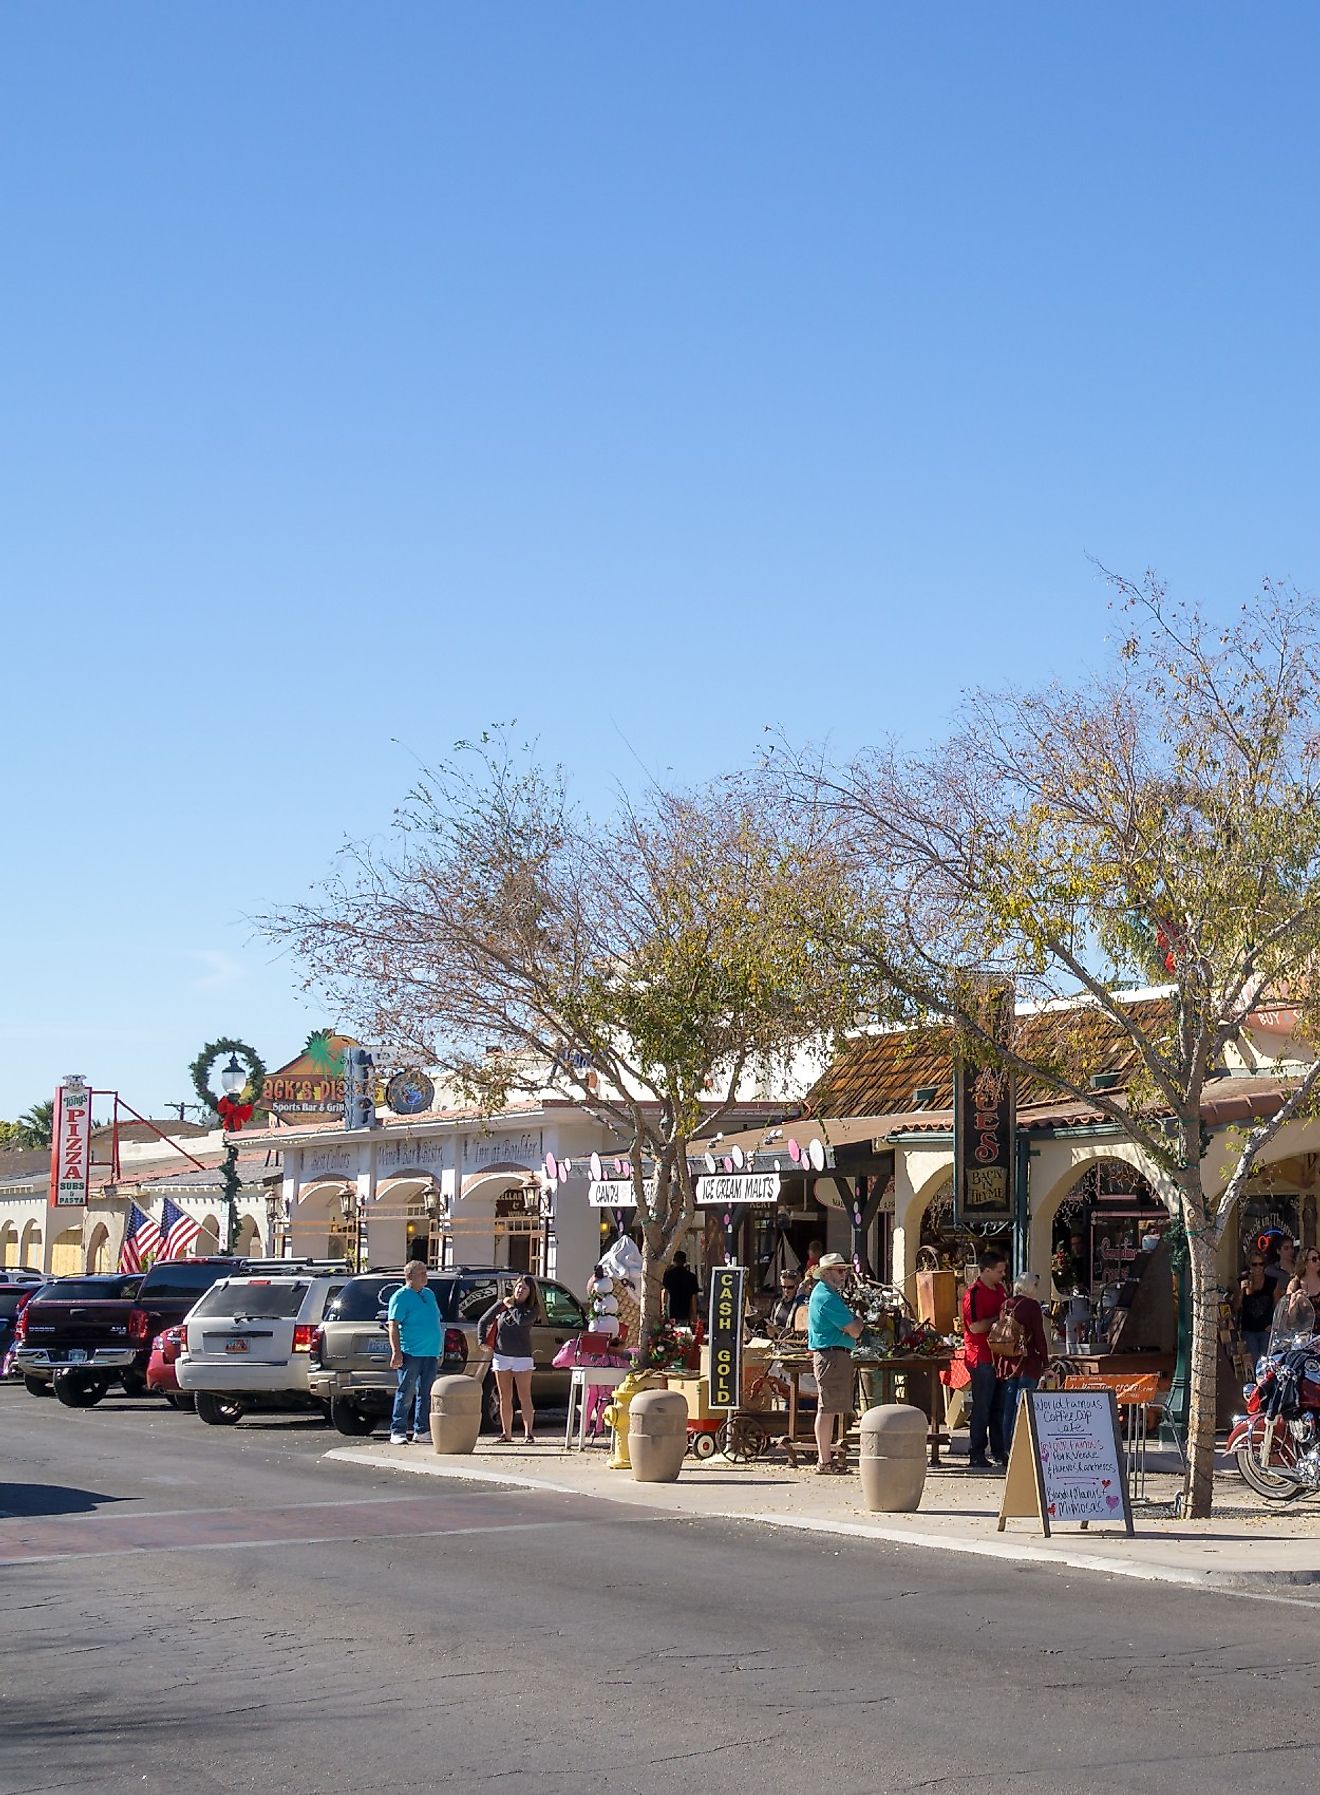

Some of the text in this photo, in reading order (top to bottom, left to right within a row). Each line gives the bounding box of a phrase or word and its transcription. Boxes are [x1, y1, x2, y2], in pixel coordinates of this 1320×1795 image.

[1258, 1013, 1280, 1025] BUY
[272, 1102, 300, 1112] Sports
[302, 1102, 317, 1112] Bar
[319, 1103, 325, 1111] &
[62, 1109, 86, 1180] PIZZA
[60, 1182, 85, 1190] SUBS
[596, 1184, 619, 1202] CANDY
[702, 1177, 775, 1199] ICE CREAM MALTS
[500, 1192, 523, 1200] ELLAR
[718, 1273, 734, 1330] CASH
[717, 1349, 731, 1403] GOLD
[1034, 1398, 1103, 1411] World Famous
[1043, 1410, 1074, 1422] Coffee
[1058, 1500, 1104, 1517] Mimosas
